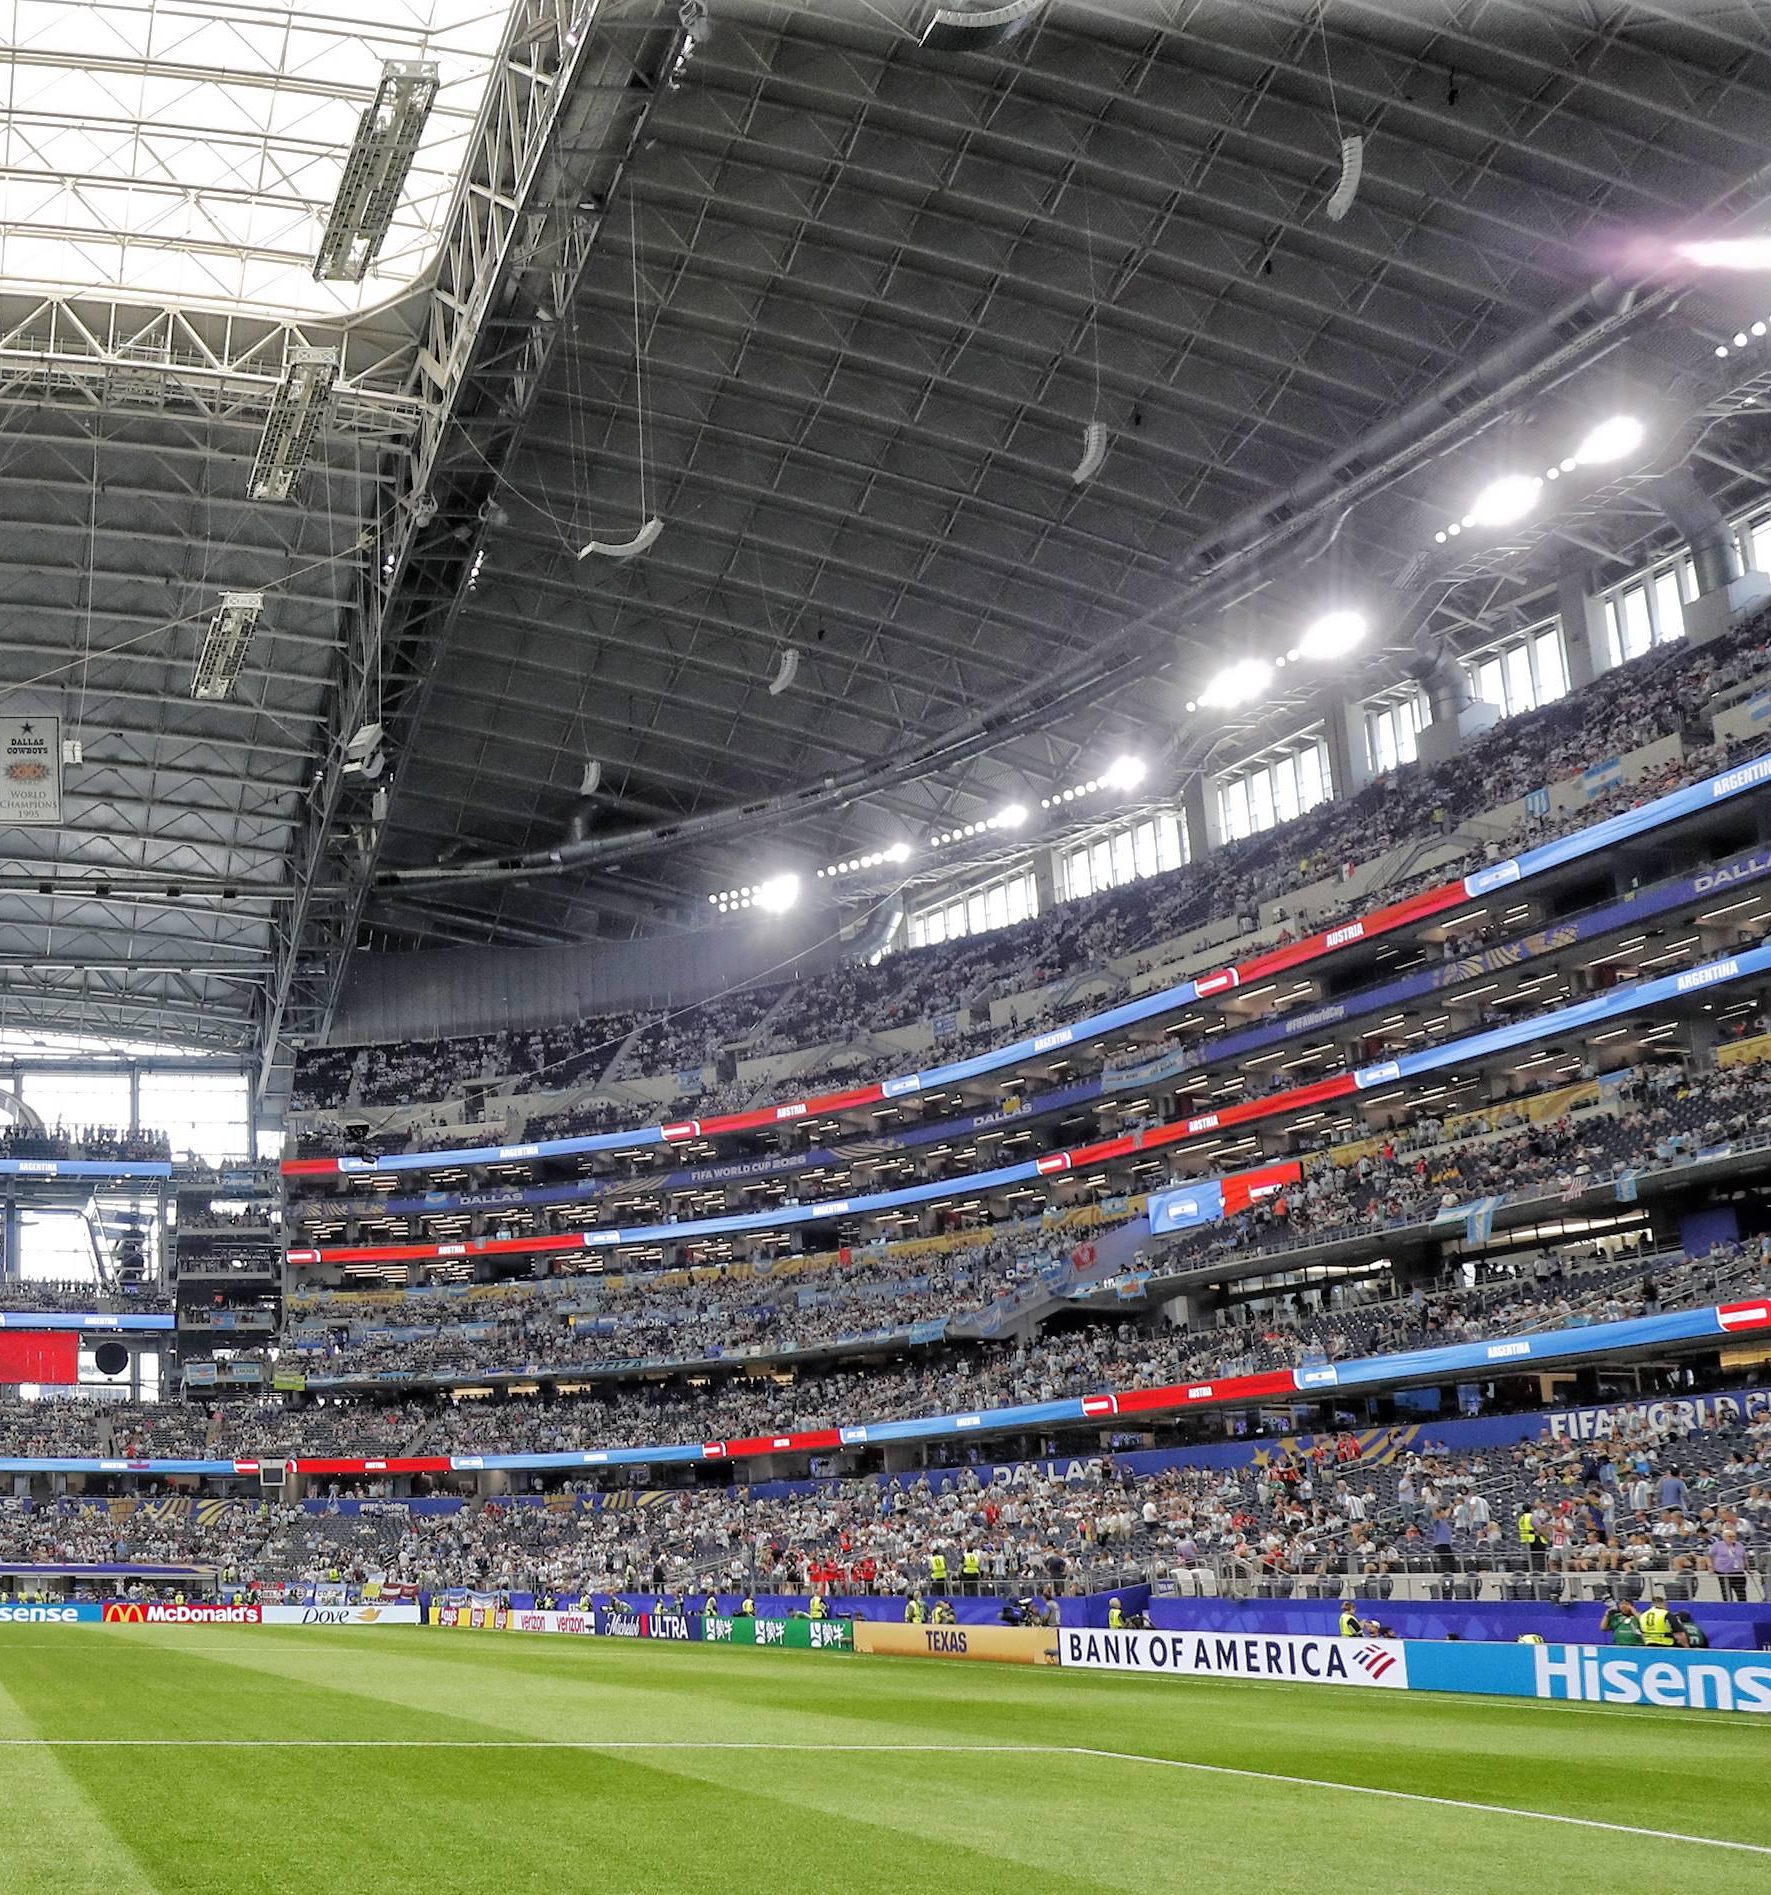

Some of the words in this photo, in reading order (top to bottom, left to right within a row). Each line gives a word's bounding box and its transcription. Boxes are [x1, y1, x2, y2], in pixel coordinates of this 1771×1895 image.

[11, 738, 44, 746] DALLAS
[1713, 759, 1771, 797] ARGENTIN
[10, 791, 46, 799] WORLD
[0, 800, 57, 809] CHAMPIONS
[19, 810, 40, 818] 1995
[1325, 923, 1364, 947] AUSTRIA
[1678, 960, 1738, 991] ARGENTINA
[1286, 1006, 1346, 1033] #FIFAWorldCup
[1034, 1029, 1073, 1052] ARGENTINA
[777, 1103, 807, 1120] AUSTRIA
[973, 1102, 1033, 1127] DALLAS
[1188, 1115, 1219, 1133] AUSTRIA
[500, 1145, 538, 1159] ARGENTINA
[19, 1162, 57, 1172] ARGENTINA
[691, 1169, 712, 1181] FIFA
[712, 1164, 750, 1178] WORLD
[751, 1159, 772, 1173] CUP
[771, 1154, 806, 1170] 2026
[459, 1191, 524, 1206] DALLAS
[813, 1202, 849, 1217] ARGENTINA
[438, 1244, 466, 1255] AUSTRIA
[1487, 1342, 1531, 1358] ARGENTINA
[1549, 1409, 1614, 1440] FIFA
[1621, 1396, 1741, 1440] ORLD
[147, 1605, 258, 1622] McDonald's
[302, 1606, 350, 1624] Dove
[520, 1615, 545, 1631] verizon
[556, 1615, 585, 1633] verizon
[604, 1612, 640, 1638] Michelob
[649, 1615, 689, 1640] ULTRA
[925, 1630, 968, 1653] TEXAS
[1069, 1633, 1140, 1665] BANK
[1149, 1636, 1184, 1667] OF
[1194, 1639, 1348, 1679] AMERICA
[1534, 1644, 1771, 1713] Hisens
